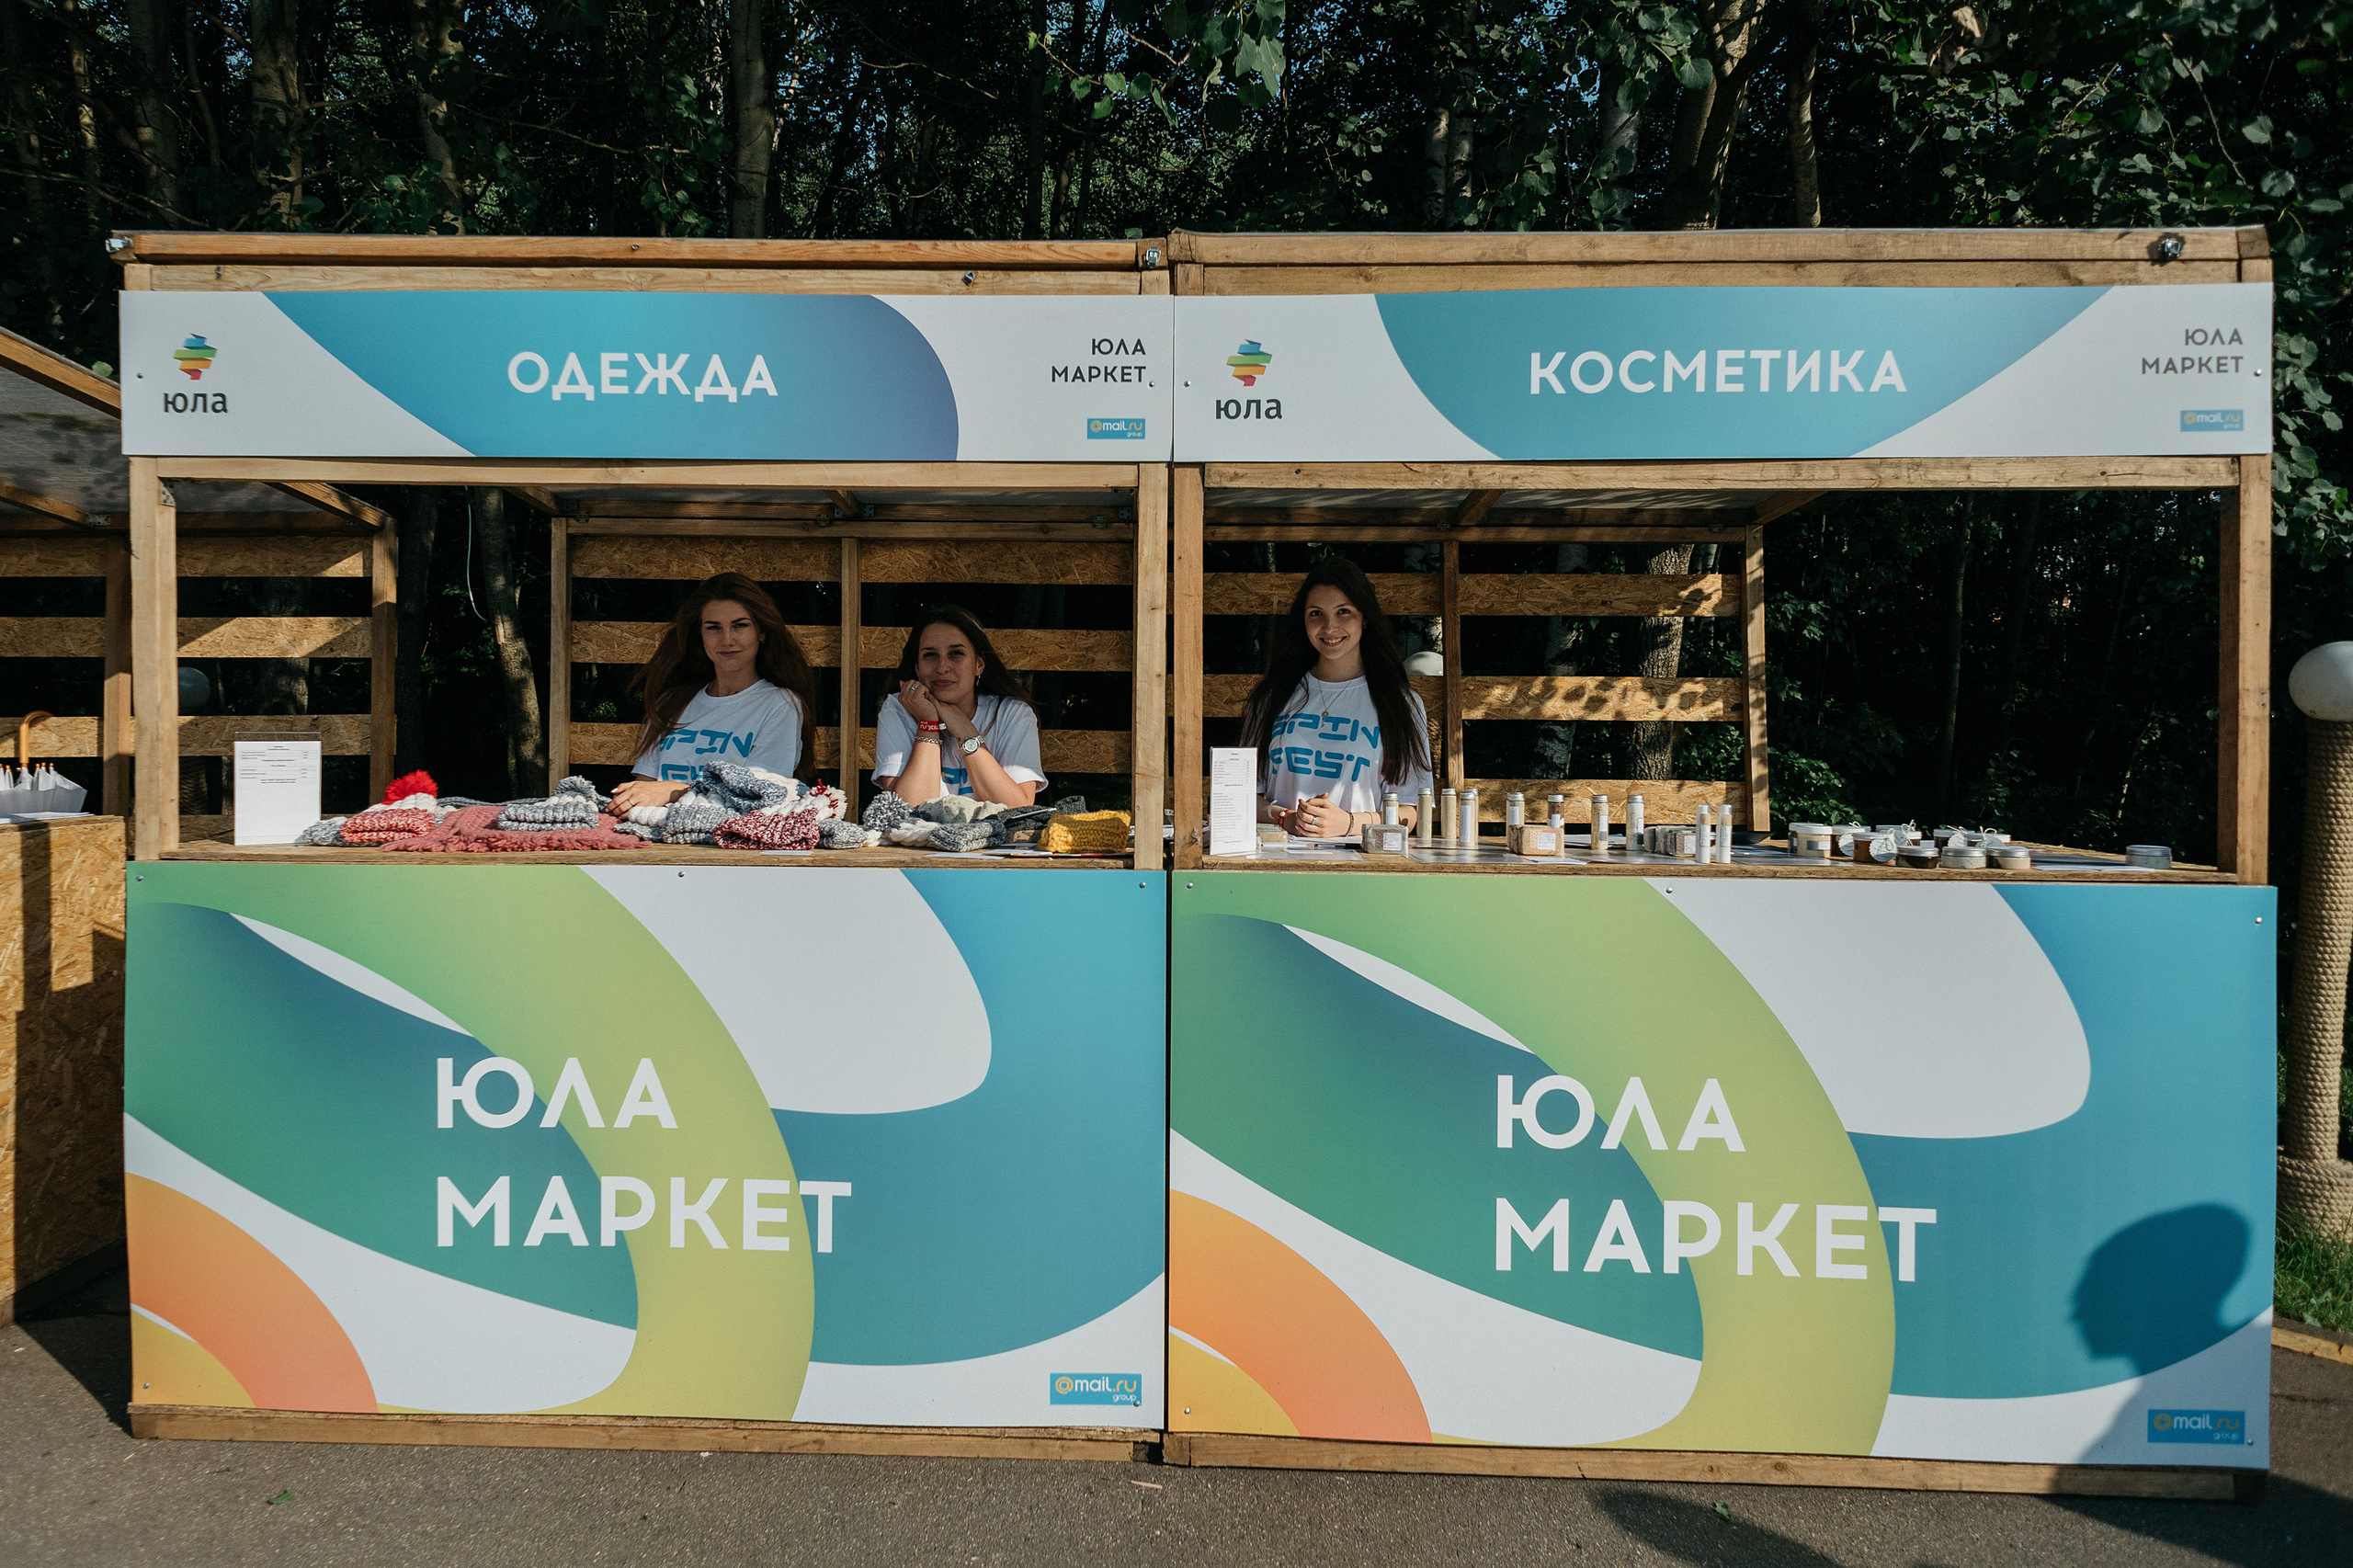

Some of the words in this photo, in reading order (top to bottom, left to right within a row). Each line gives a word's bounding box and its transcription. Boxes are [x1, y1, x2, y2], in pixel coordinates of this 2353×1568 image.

[1091, 338, 1147, 356] ЮЛА
[2185, 328, 2243, 346] ЮЛА
[507, 351, 779, 403] ОДЕЖДА
[1051, 365, 1147, 383] МАРКЕТ
[1529, 349, 1907, 395] КОСМЕТИКА
[2142, 357, 2243, 374] МАРКЕТ
[163, 392, 229, 415] юла
[1215, 398, 1283, 420] юла
[437, 1056, 678, 1129] ЮЛА
[1496, 1074, 1745, 1153] ЮЛА
[437, 1176, 853, 1254] МАРКЕТ
[1495, 1197, 1938, 1282] МАРКЕТ
[1112, 1393, 1137, 1403] group
